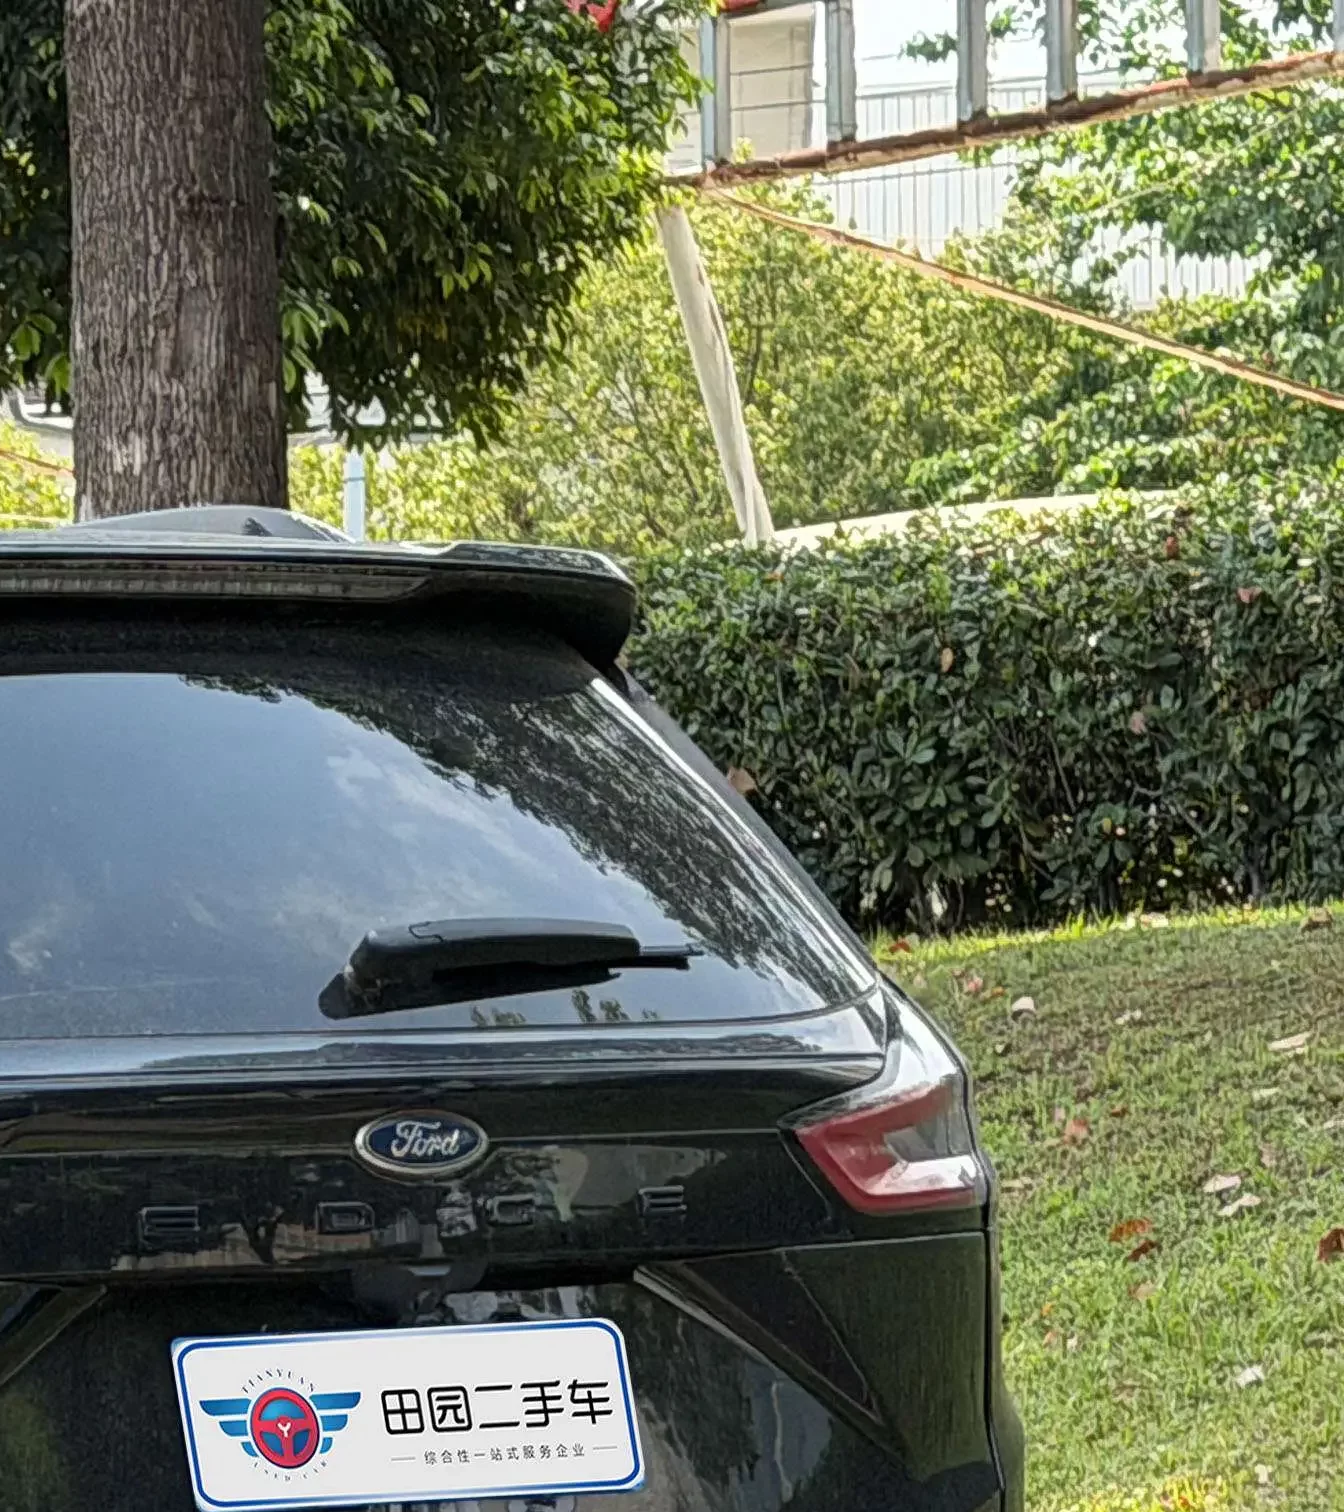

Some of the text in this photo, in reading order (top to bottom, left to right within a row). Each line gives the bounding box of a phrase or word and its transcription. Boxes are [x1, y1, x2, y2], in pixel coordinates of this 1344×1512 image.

[391, 1120, 460, 1157] Ford
[139, 1185, 688, 1237] EDGE
[381, 1380, 612, 1434] 田园二手车
[423, 1444, 585, 1465] 综合性一站式服务企业
